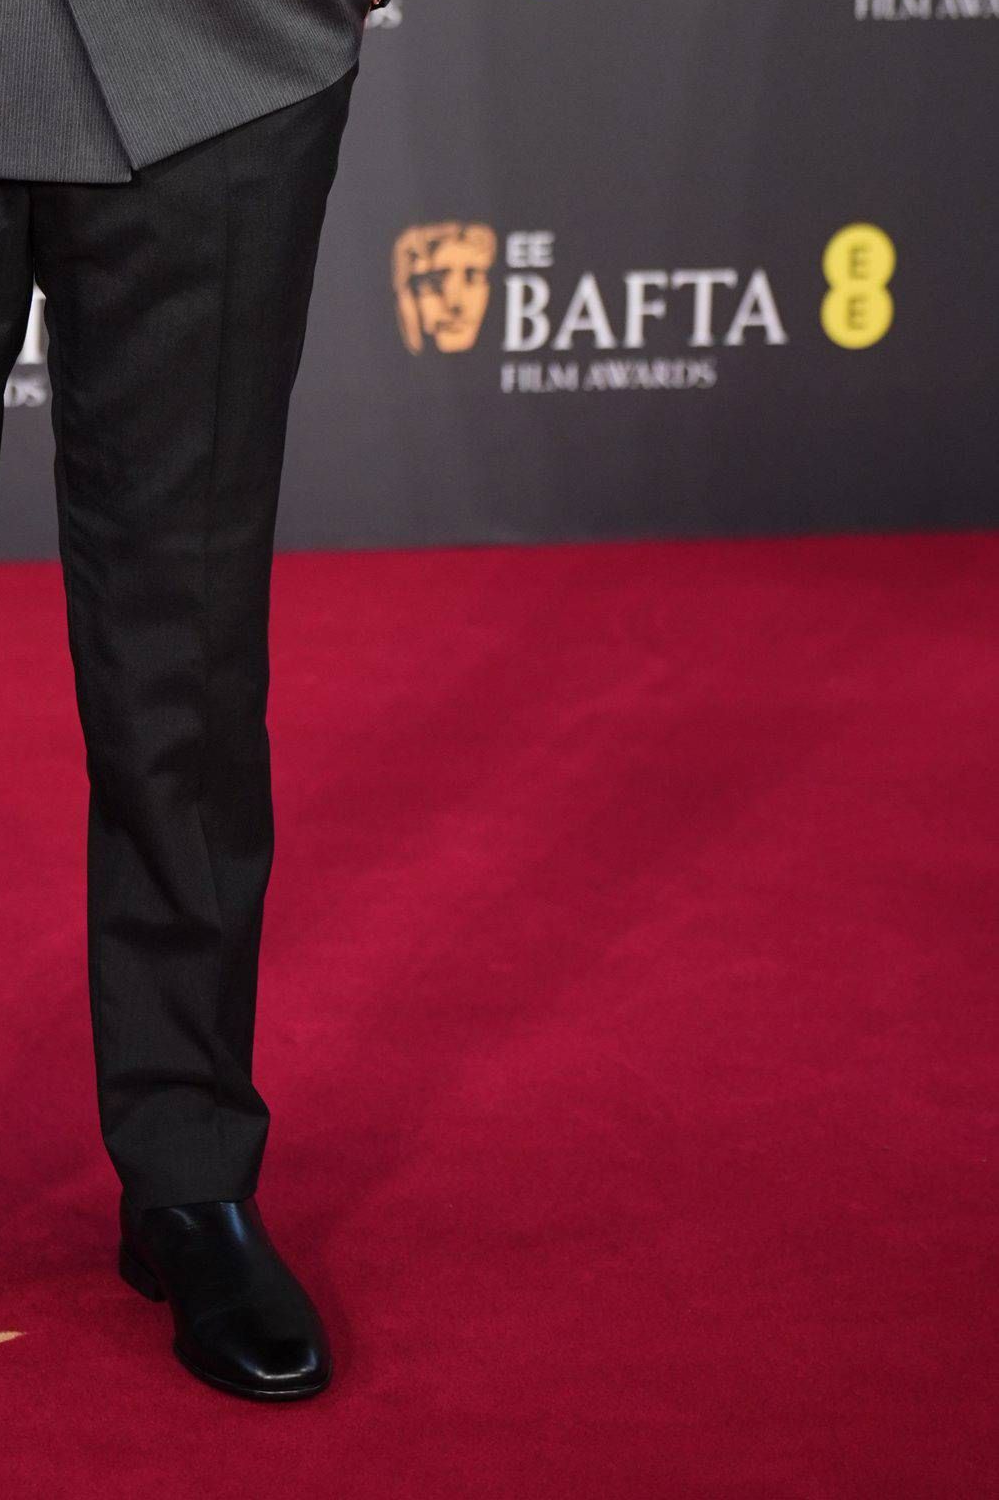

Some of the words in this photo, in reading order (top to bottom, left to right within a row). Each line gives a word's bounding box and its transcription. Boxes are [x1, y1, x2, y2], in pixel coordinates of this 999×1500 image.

[506, 232, 553, 268] EE
[503, 269, 787, 351] BAFTA
[501, 363, 578, 392] FILM
[585, 360, 716, 389] AWARDS
